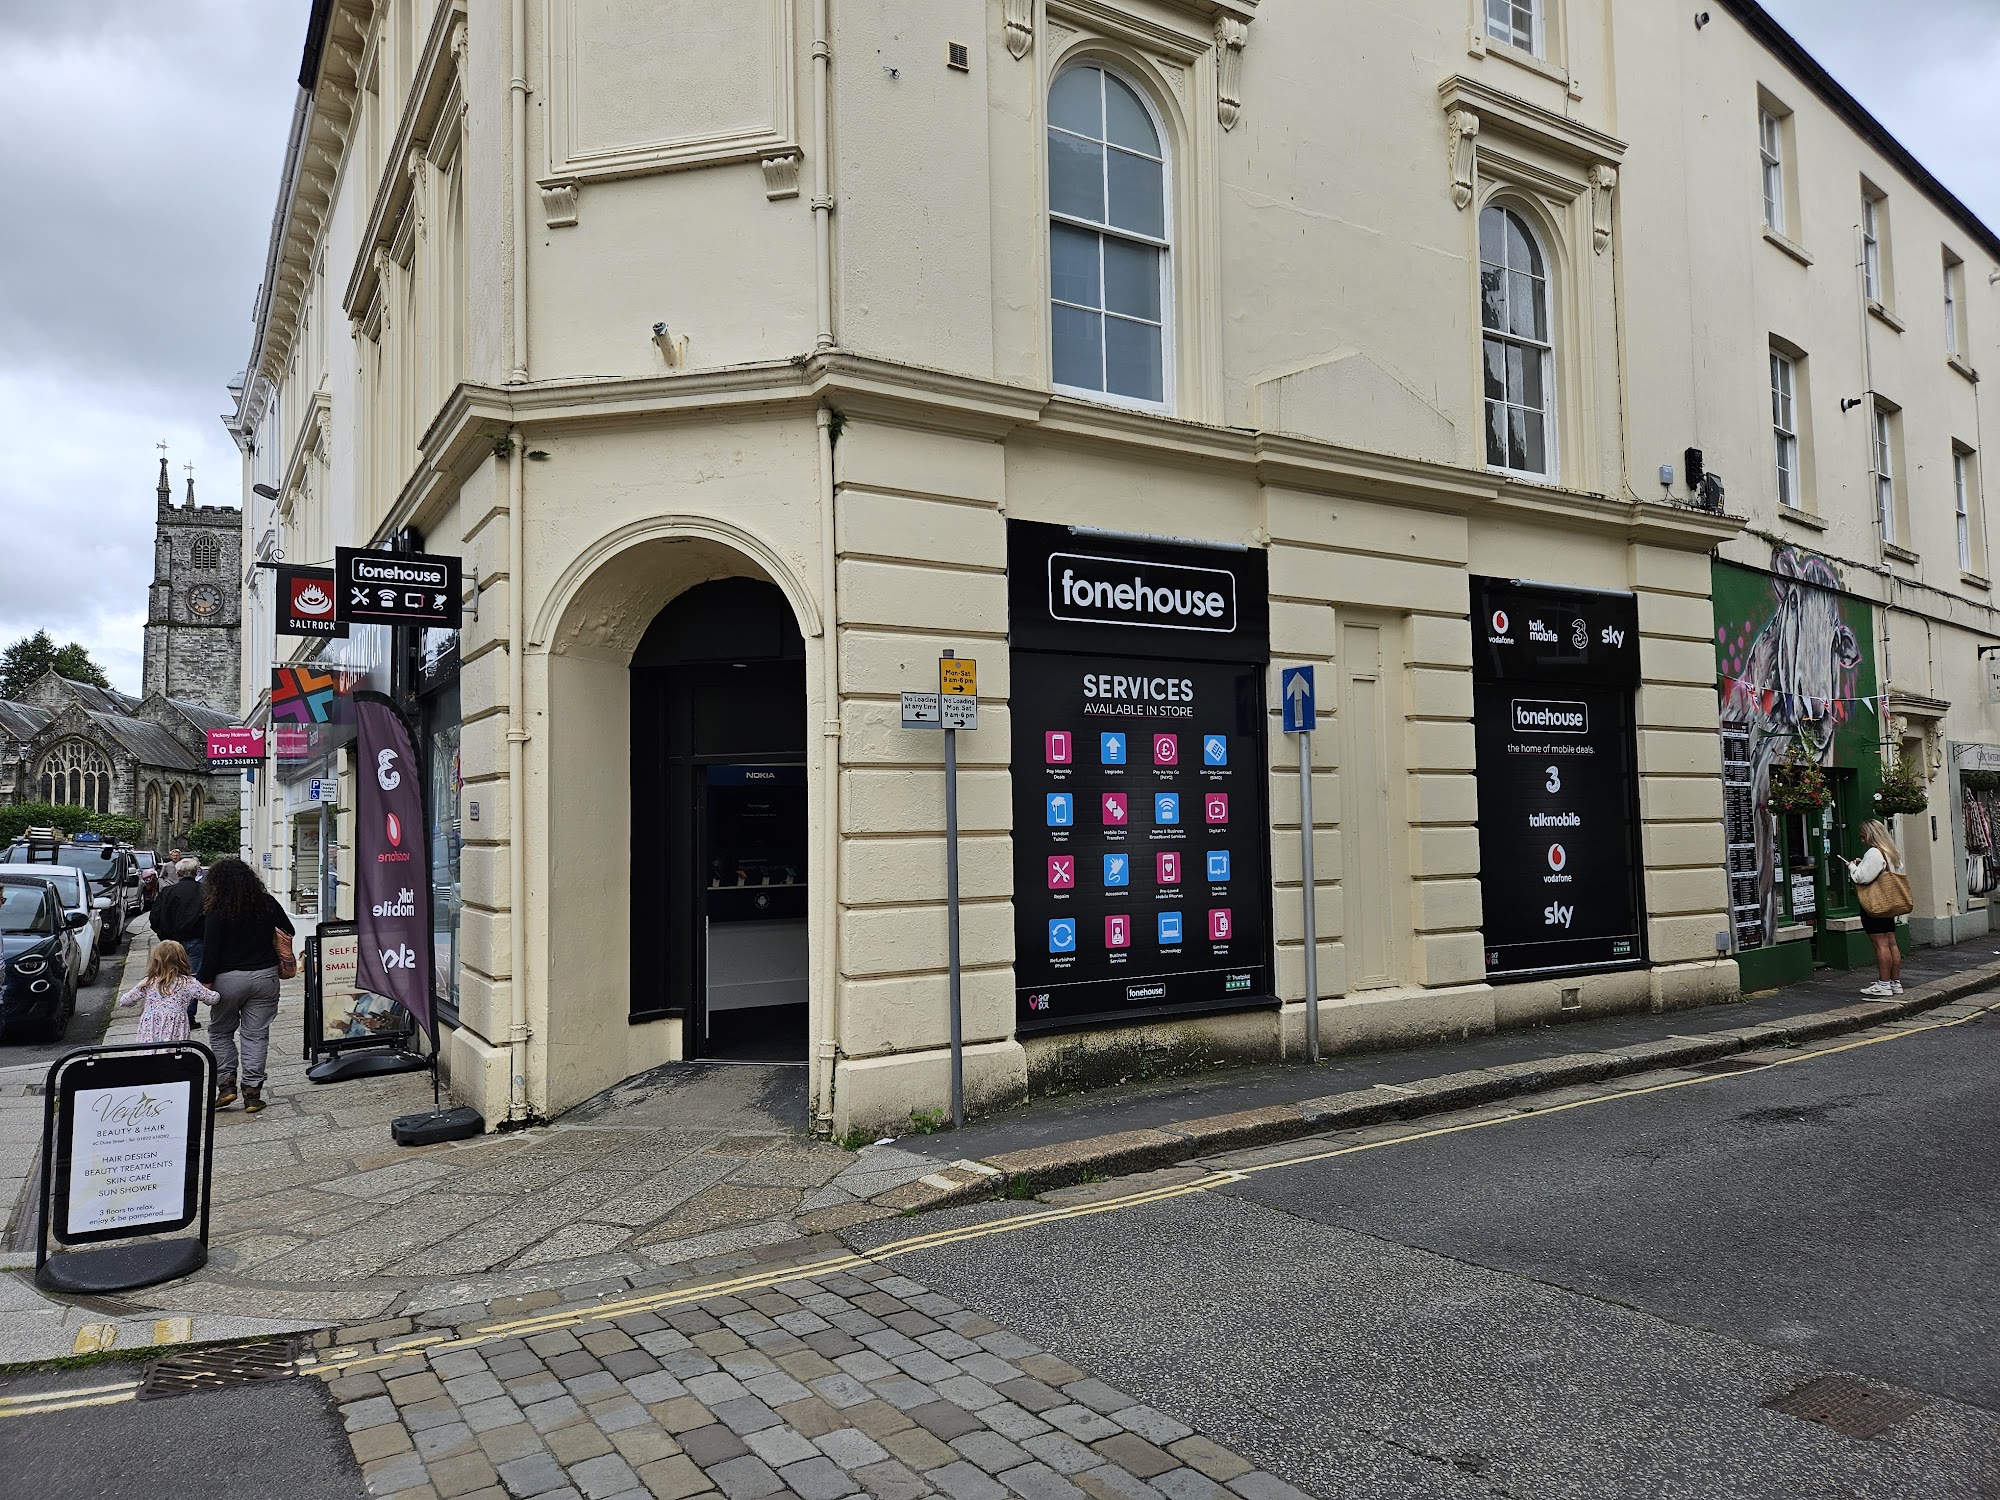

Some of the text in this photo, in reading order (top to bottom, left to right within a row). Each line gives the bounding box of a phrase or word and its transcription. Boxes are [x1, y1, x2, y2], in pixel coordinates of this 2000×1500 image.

[358, 563, 441, 583] fonehouse
[1061, 568, 1225, 618] fonehouse
[289, 619, 336, 631] SALTROCK
[1528, 619, 1545, 632] talk
[1488, 636, 1515, 645] vodafone
[1529, 630, 1559, 643] mobile
[1601, 625, 1625, 648] sky
[1083, 673, 1194, 701] SERVICES
[953, 698, 975, 706] Loading
[1083, 702, 1194, 717] AVAILABLE IN STORE
[1516, 706, 1584, 727] fonehouse
[211, 743, 248, 755] To Let
[1507, 743, 1596, 755] the home of mobile deals.
[211, 758, 233, 766] 01752
[1545, 765, 1561, 794] 3
[1528, 812, 1581, 828] talkmobile
[1543, 873, 1573, 883] vodafone
[1543, 900, 1575, 929] sky
[328, 947, 350, 956] SELF
[1050, 956, 1076, 964] Refurbished
[325, 962, 357, 972] SMALL
[1128, 986, 1164, 998] fonehouse
[91, 1093, 173, 1127] Venus
[96, 1127, 132, 1138] BEAUTY
[143, 1124, 166, 1132] HAIR
[101, 1151, 158, 1164] HAIR DESIGN
[84, 1160, 174, 1177] BEAUTY TREATMENTS
[106, 1173, 151, 1186] SKIN CARE
[98, 1183, 158, 1198] SUN SHOWER
[106, 1206, 126, 1216] floors
[136, 1203, 155, 1211] relax,
[89, 1217, 109, 1226] enjoy
